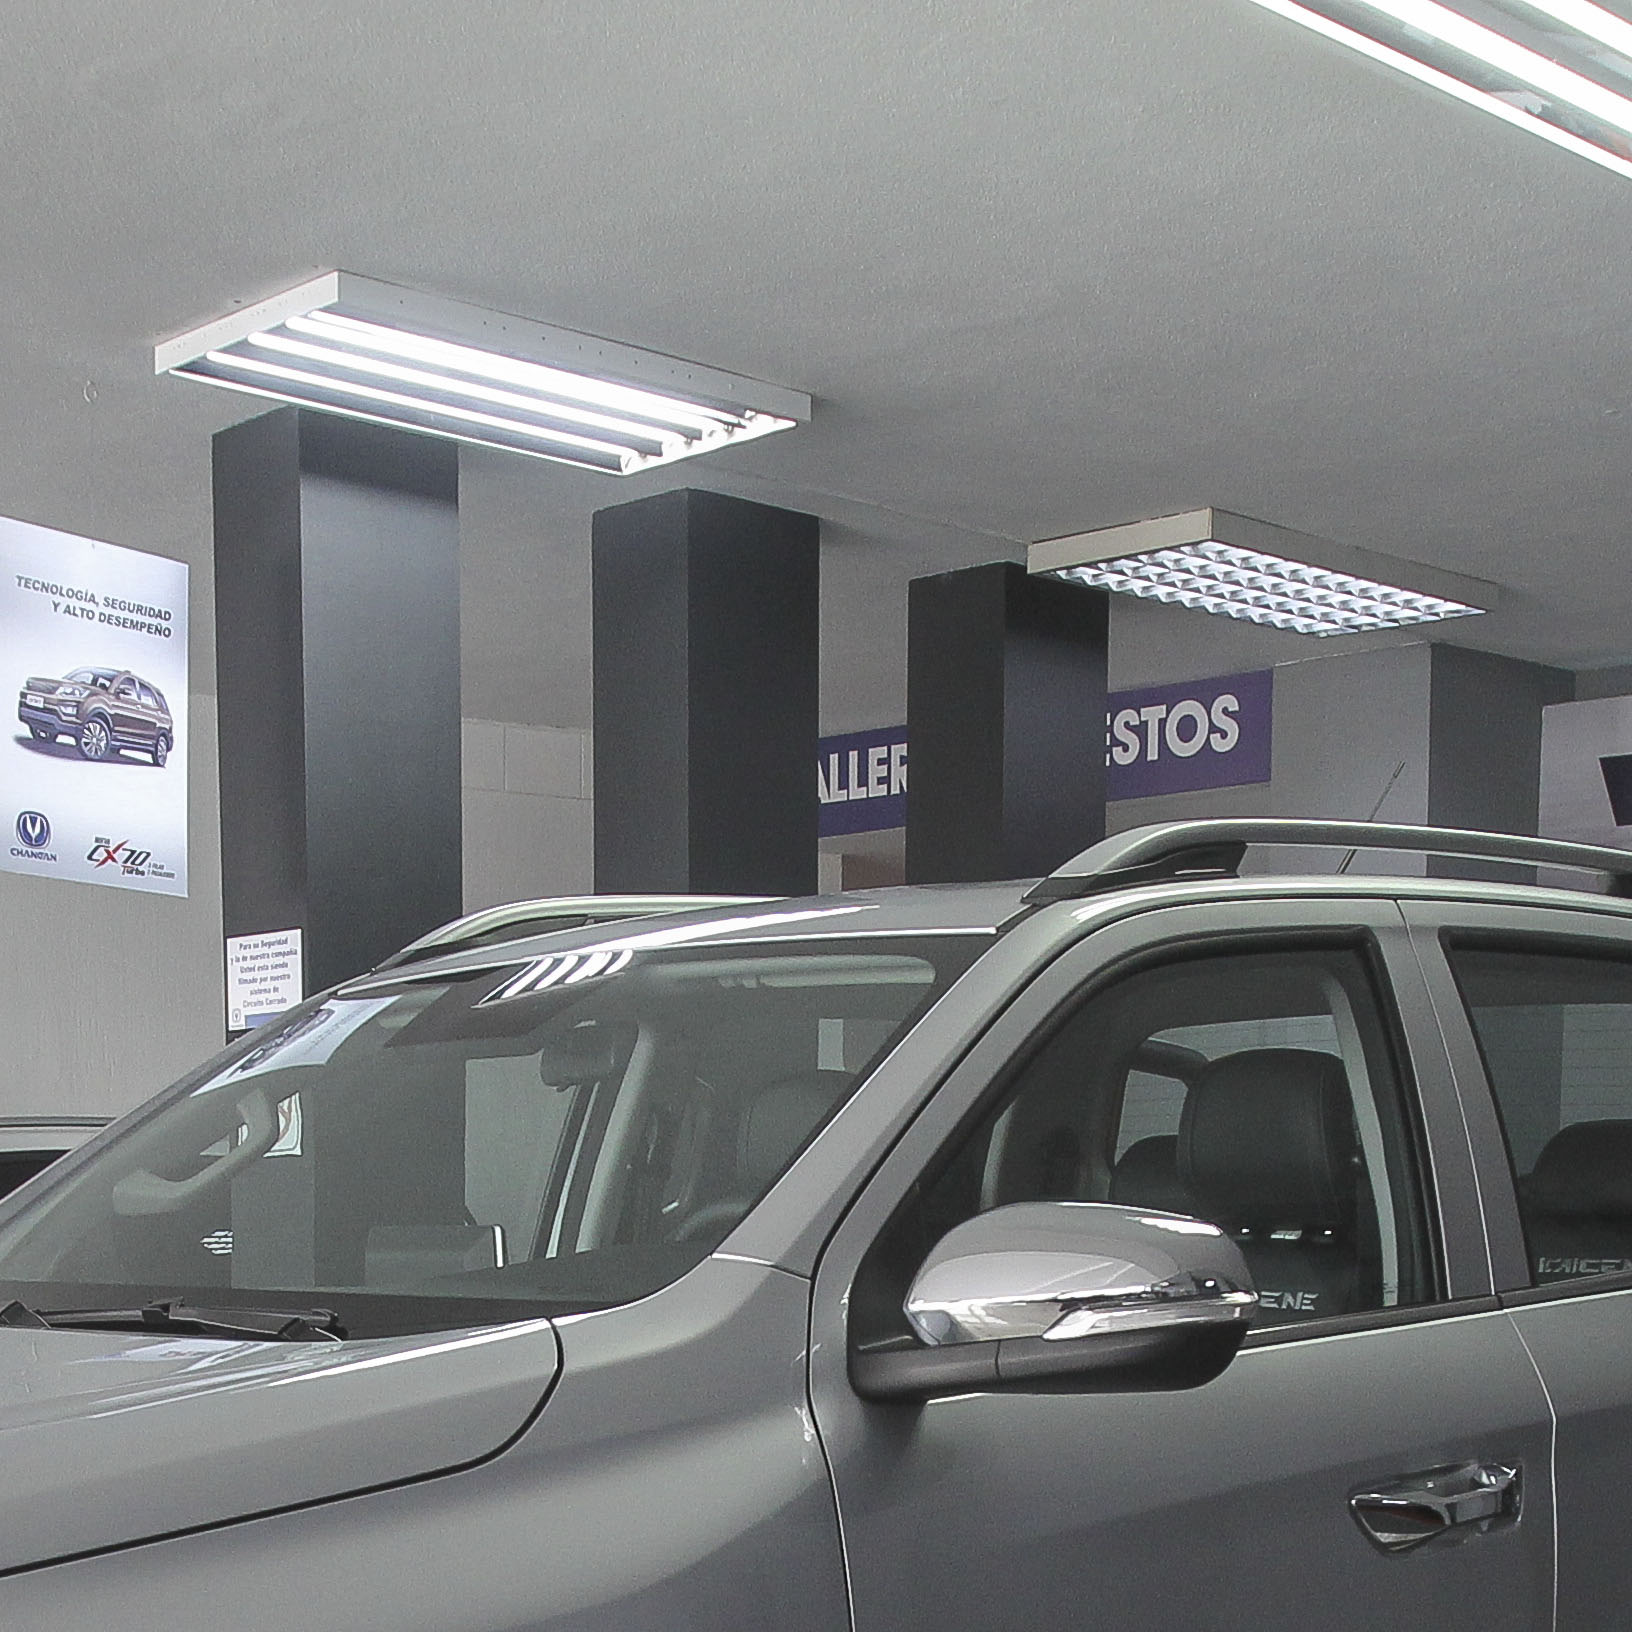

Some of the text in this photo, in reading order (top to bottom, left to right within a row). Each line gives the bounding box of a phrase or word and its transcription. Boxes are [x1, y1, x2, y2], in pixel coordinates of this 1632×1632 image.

[16, 575, 172, 622] TECNOLOGÍA, SEGURIDAD
[51, 600, 172, 638] Y ALTO DESEMPEÑO
[10, 847, 58, 862] CHANGAN
